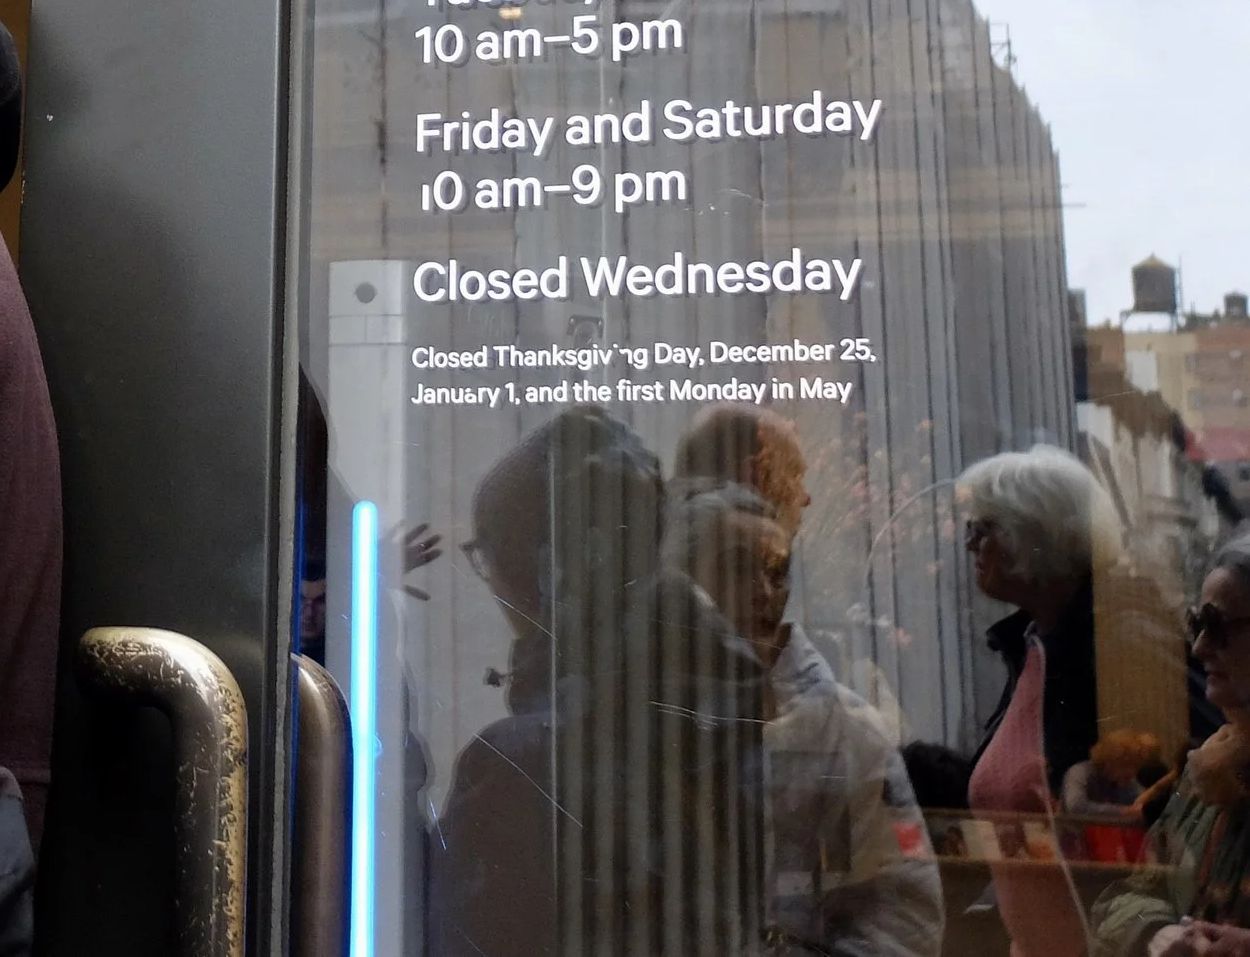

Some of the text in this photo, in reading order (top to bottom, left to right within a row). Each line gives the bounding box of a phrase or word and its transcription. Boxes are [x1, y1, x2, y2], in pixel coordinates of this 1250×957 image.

[416, 25, 463, 63] 10
[613, 20, 681, 61] pm
[417, 91, 881, 156] Friday and Saturday
[616, 171, 685, 212] pm
[414, 248, 861, 301] Closed Wednesday
[412, 339, 876, 370] Closed Thanksgivng Day, December 25,
[412, 378, 852, 407] January 1, and the first Monday in May
